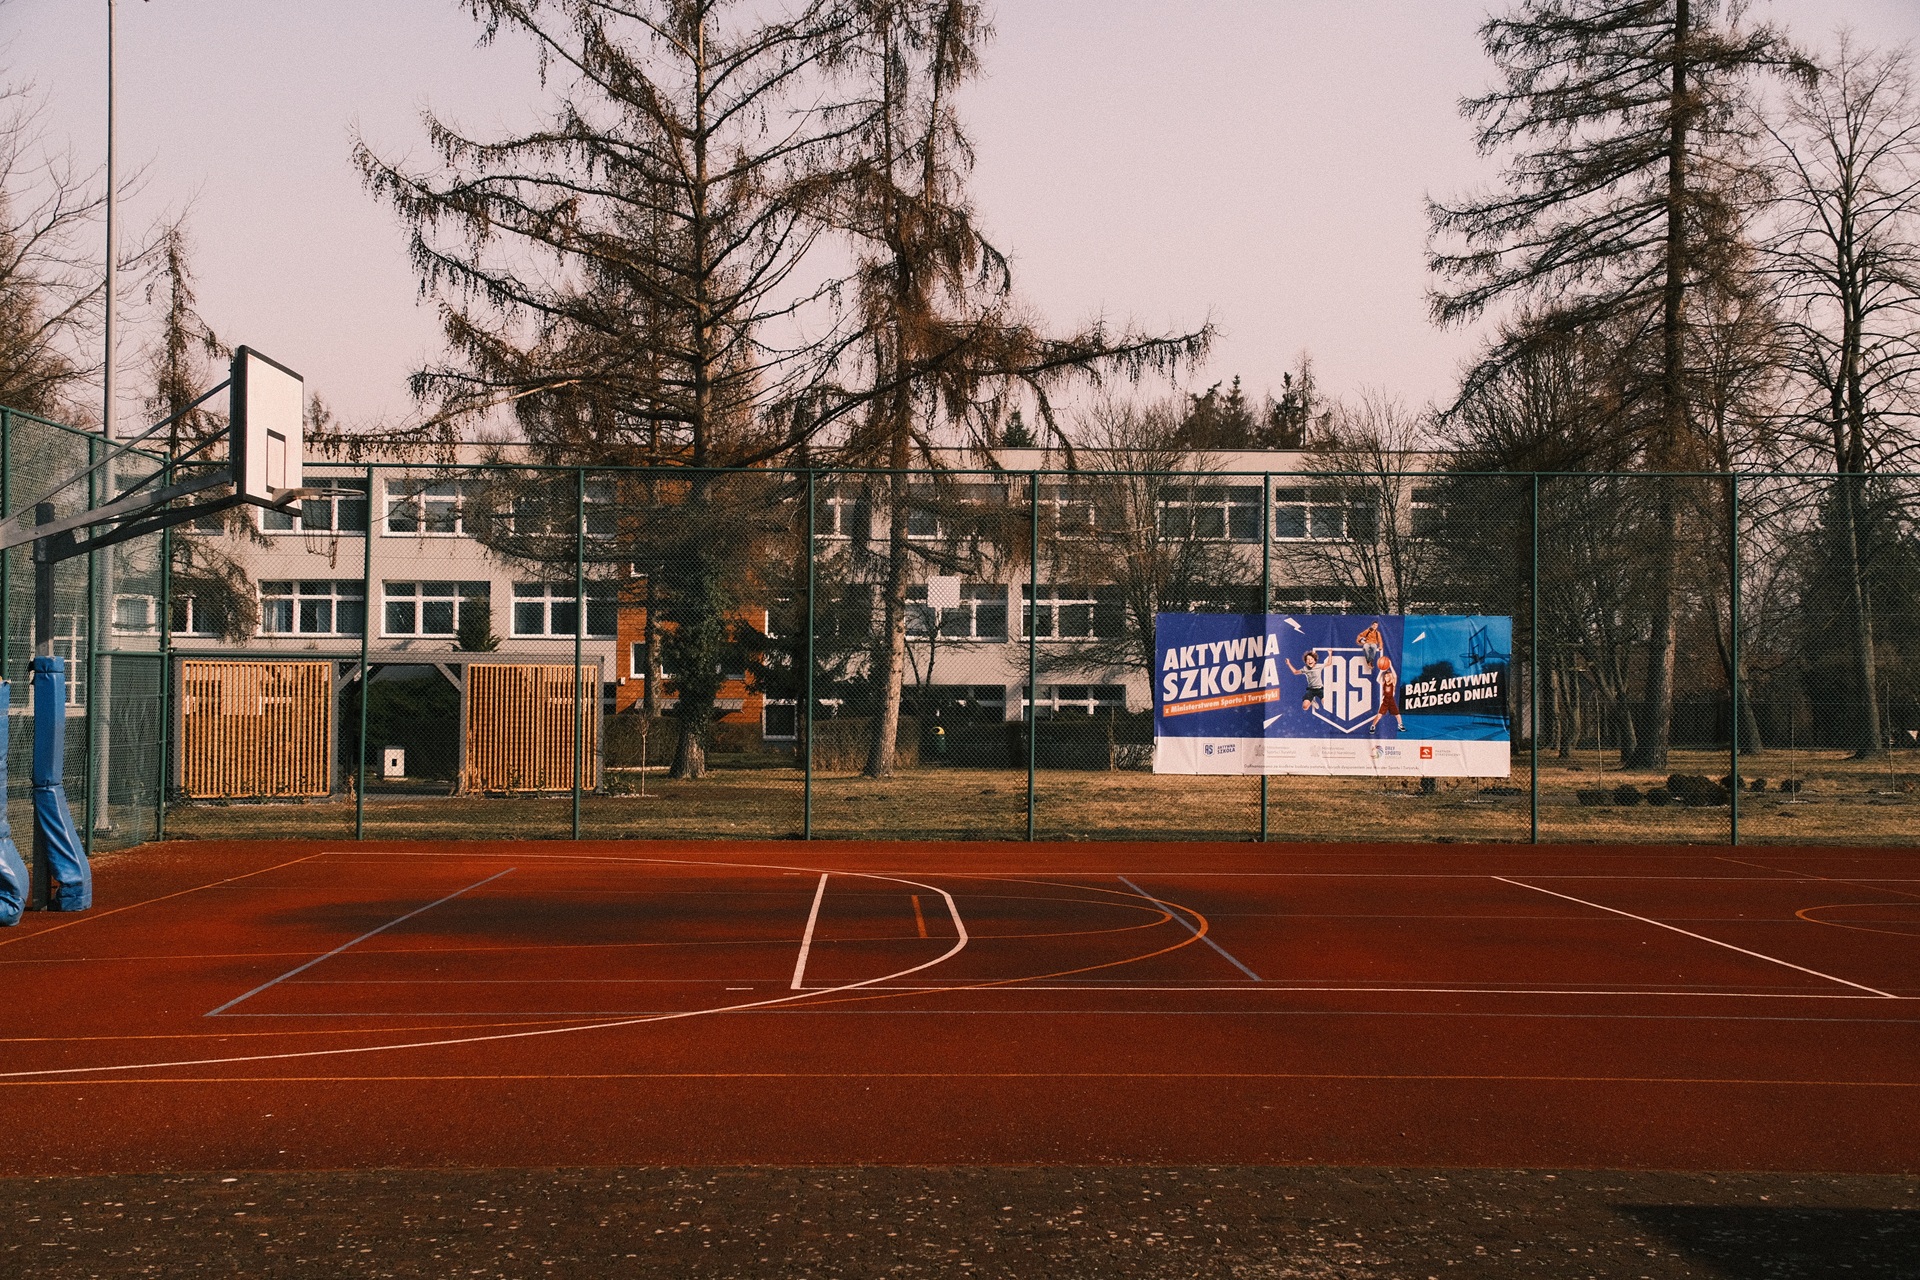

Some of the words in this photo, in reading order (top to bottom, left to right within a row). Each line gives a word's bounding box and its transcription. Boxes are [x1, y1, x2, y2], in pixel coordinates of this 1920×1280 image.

[1163, 633, 1280, 671] AKTYWNA
[1163, 658, 1280, 701] SZKOŁA
[1324, 656, 1372, 721] AS
[1405, 679, 1437, 697] BĄDŹ
[1440, 671, 1499, 690] AKTYWNY
[1171, 701, 1220, 713] Ministerstwem
[1221, 696, 1243, 708] Sportu
[1248, 690, 1278, 703] Turystyki
[1405, 690, 1460, 710] KAŻDEGO
[1464, 685, 1498, 701] DNIA!
